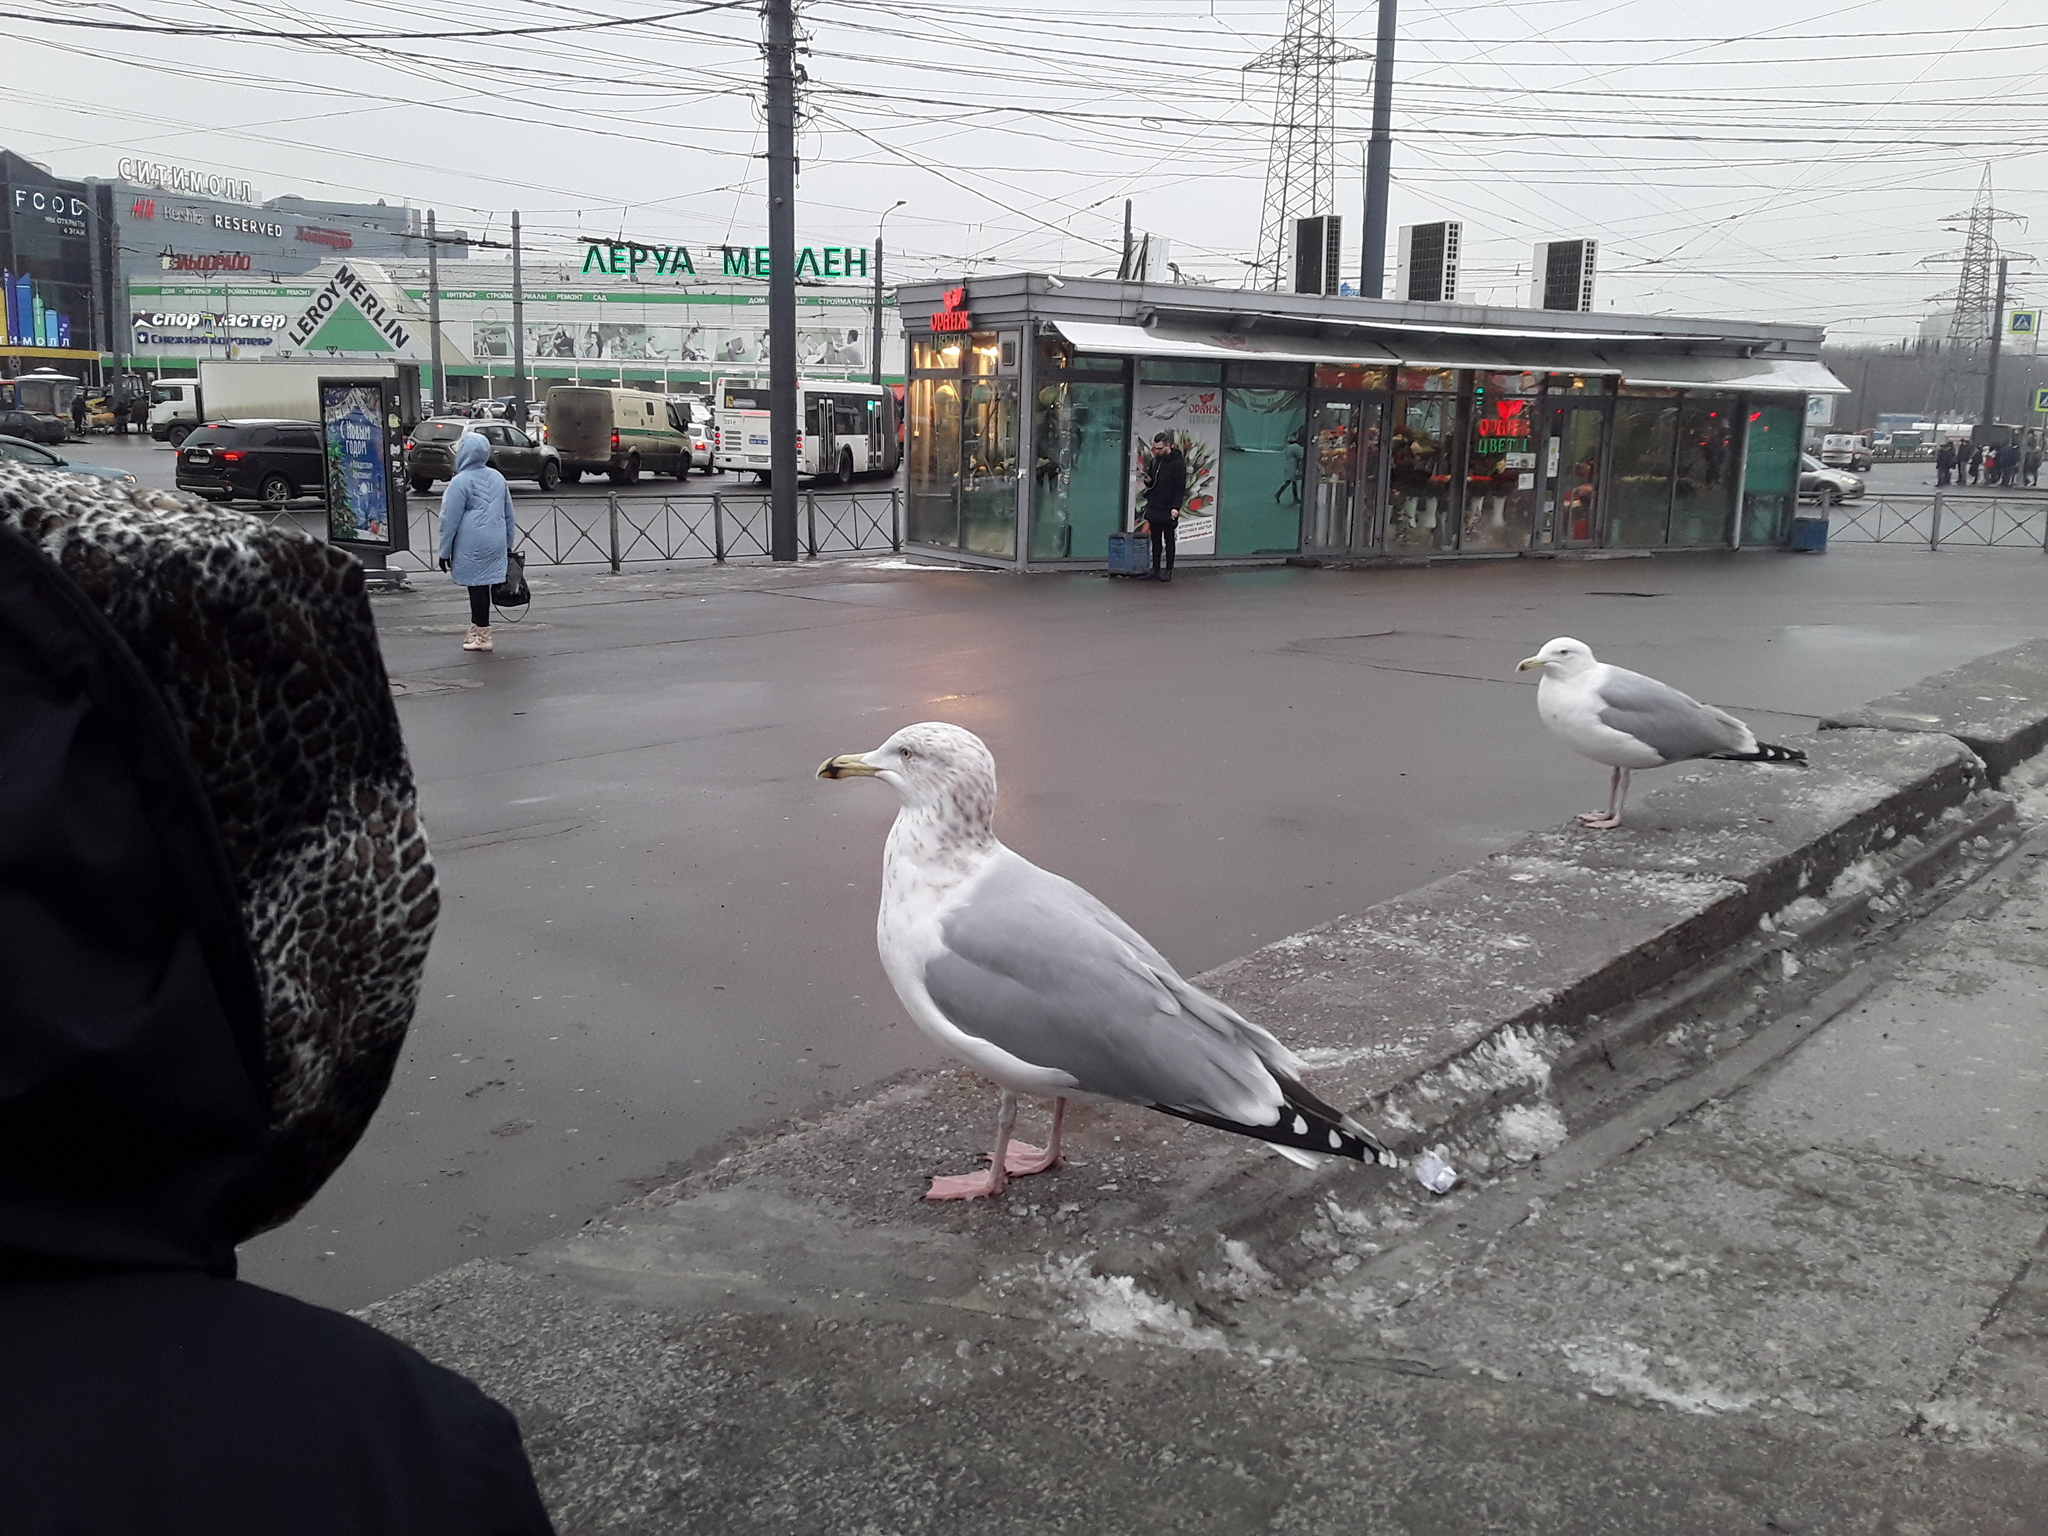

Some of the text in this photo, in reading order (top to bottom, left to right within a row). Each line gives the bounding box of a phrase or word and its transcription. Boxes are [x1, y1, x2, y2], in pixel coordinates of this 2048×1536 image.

[118, 157, 252, 201] СИТИМОЛЛ
[15, 189, 83, 216] FOOD
[213, 213, 284, 238] RESERVED
[580, 245, 868, 278] ЛЕРУА МЕЛЕН
[221, 287, 278, 296] СРОЙМАТЕРИАЛЫ
[446, 291, 477, 299] ИНТЕРЬЕР
[486, 292, 548, 301] СТРОЙМРИАЛЫ
[556, 293, 584, 301] РЕМОНТ
[592, 294, 608, 302] САД
[748, 297, 876, 306] ДОМ СТРОЙМАТЕРИА
[288, 264, 410, 349] LEROY MERLIN
[152, 312, 287, 331] спормастер
[930, 310, 970, 331] ОРАНЖ
[1479, 418, 1530, 436] ОРАН
